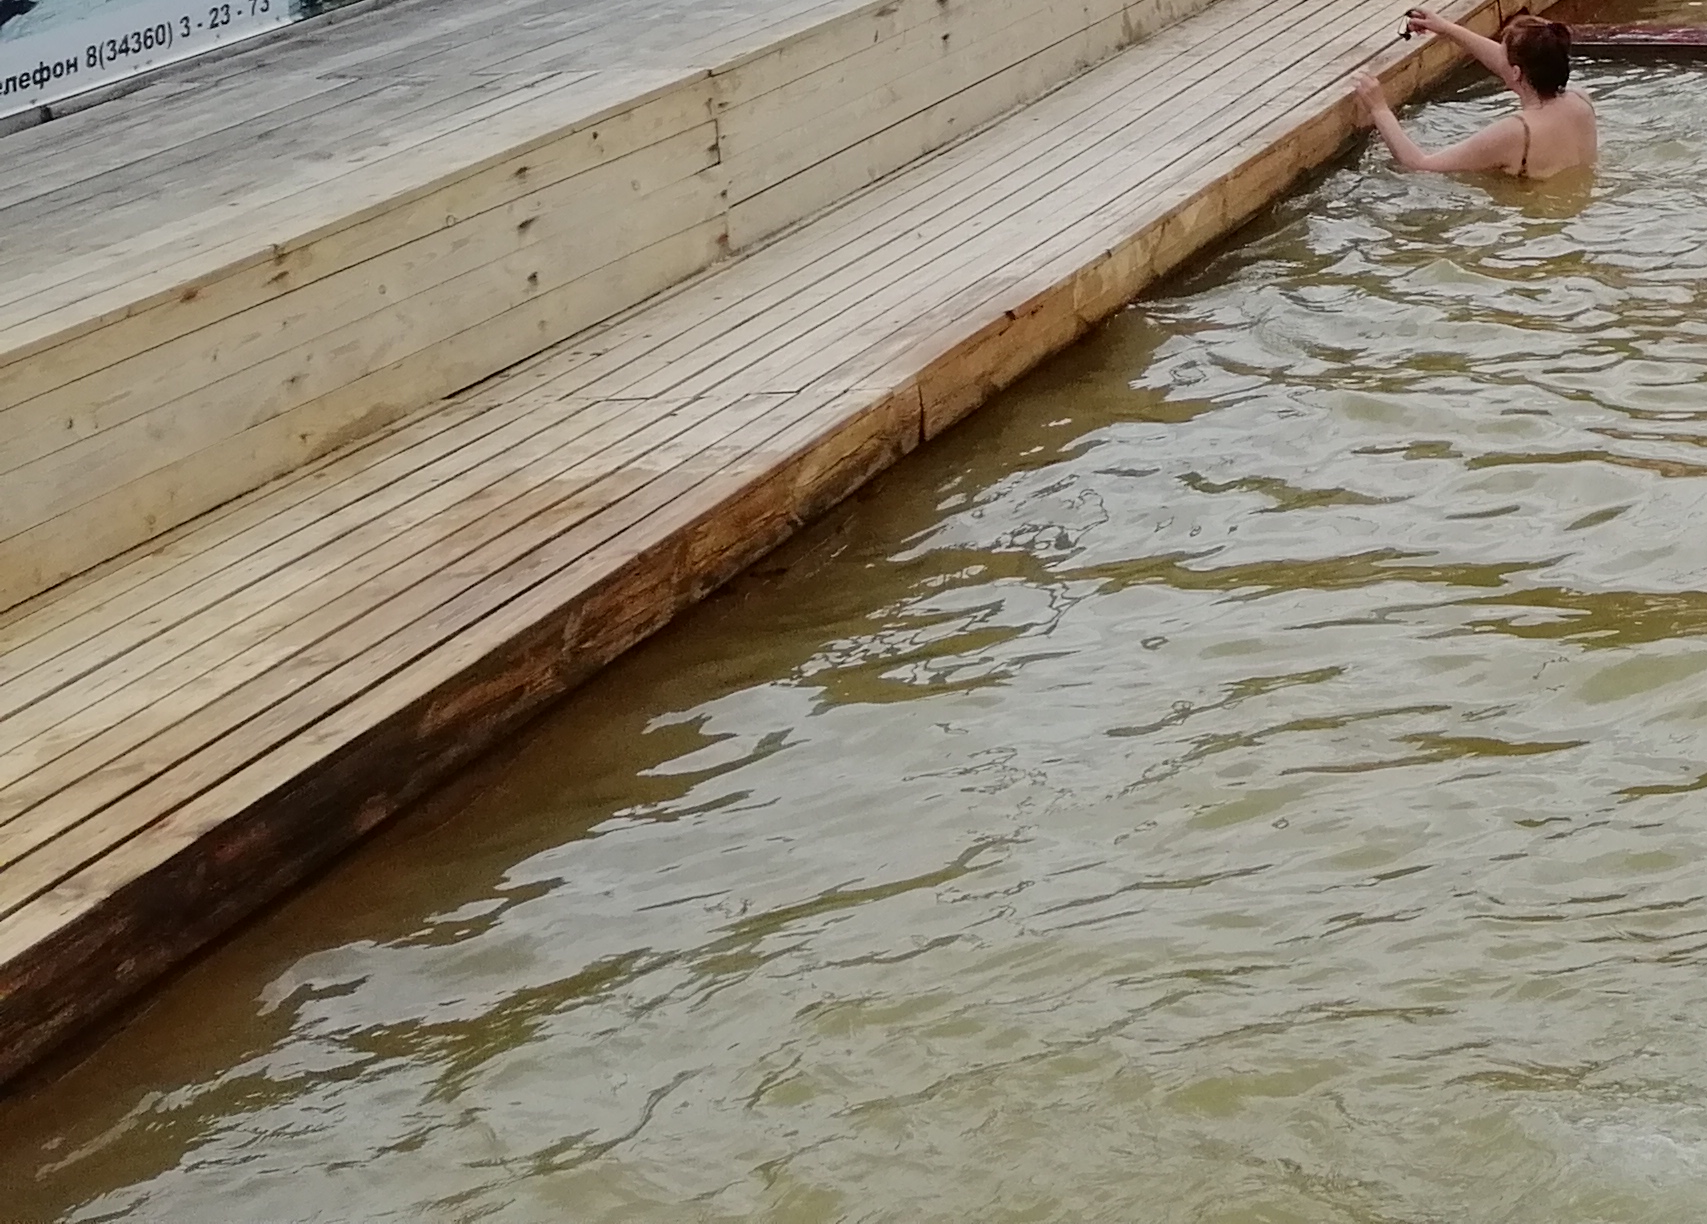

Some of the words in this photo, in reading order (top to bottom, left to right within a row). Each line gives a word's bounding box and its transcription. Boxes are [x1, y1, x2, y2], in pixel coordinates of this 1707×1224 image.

[0, 57, 78, 95] лефон
[86, 21, 173, 70] 8(34360)
[179, 15, 191, 38] 3
[208, 3, 230, 29] 23
